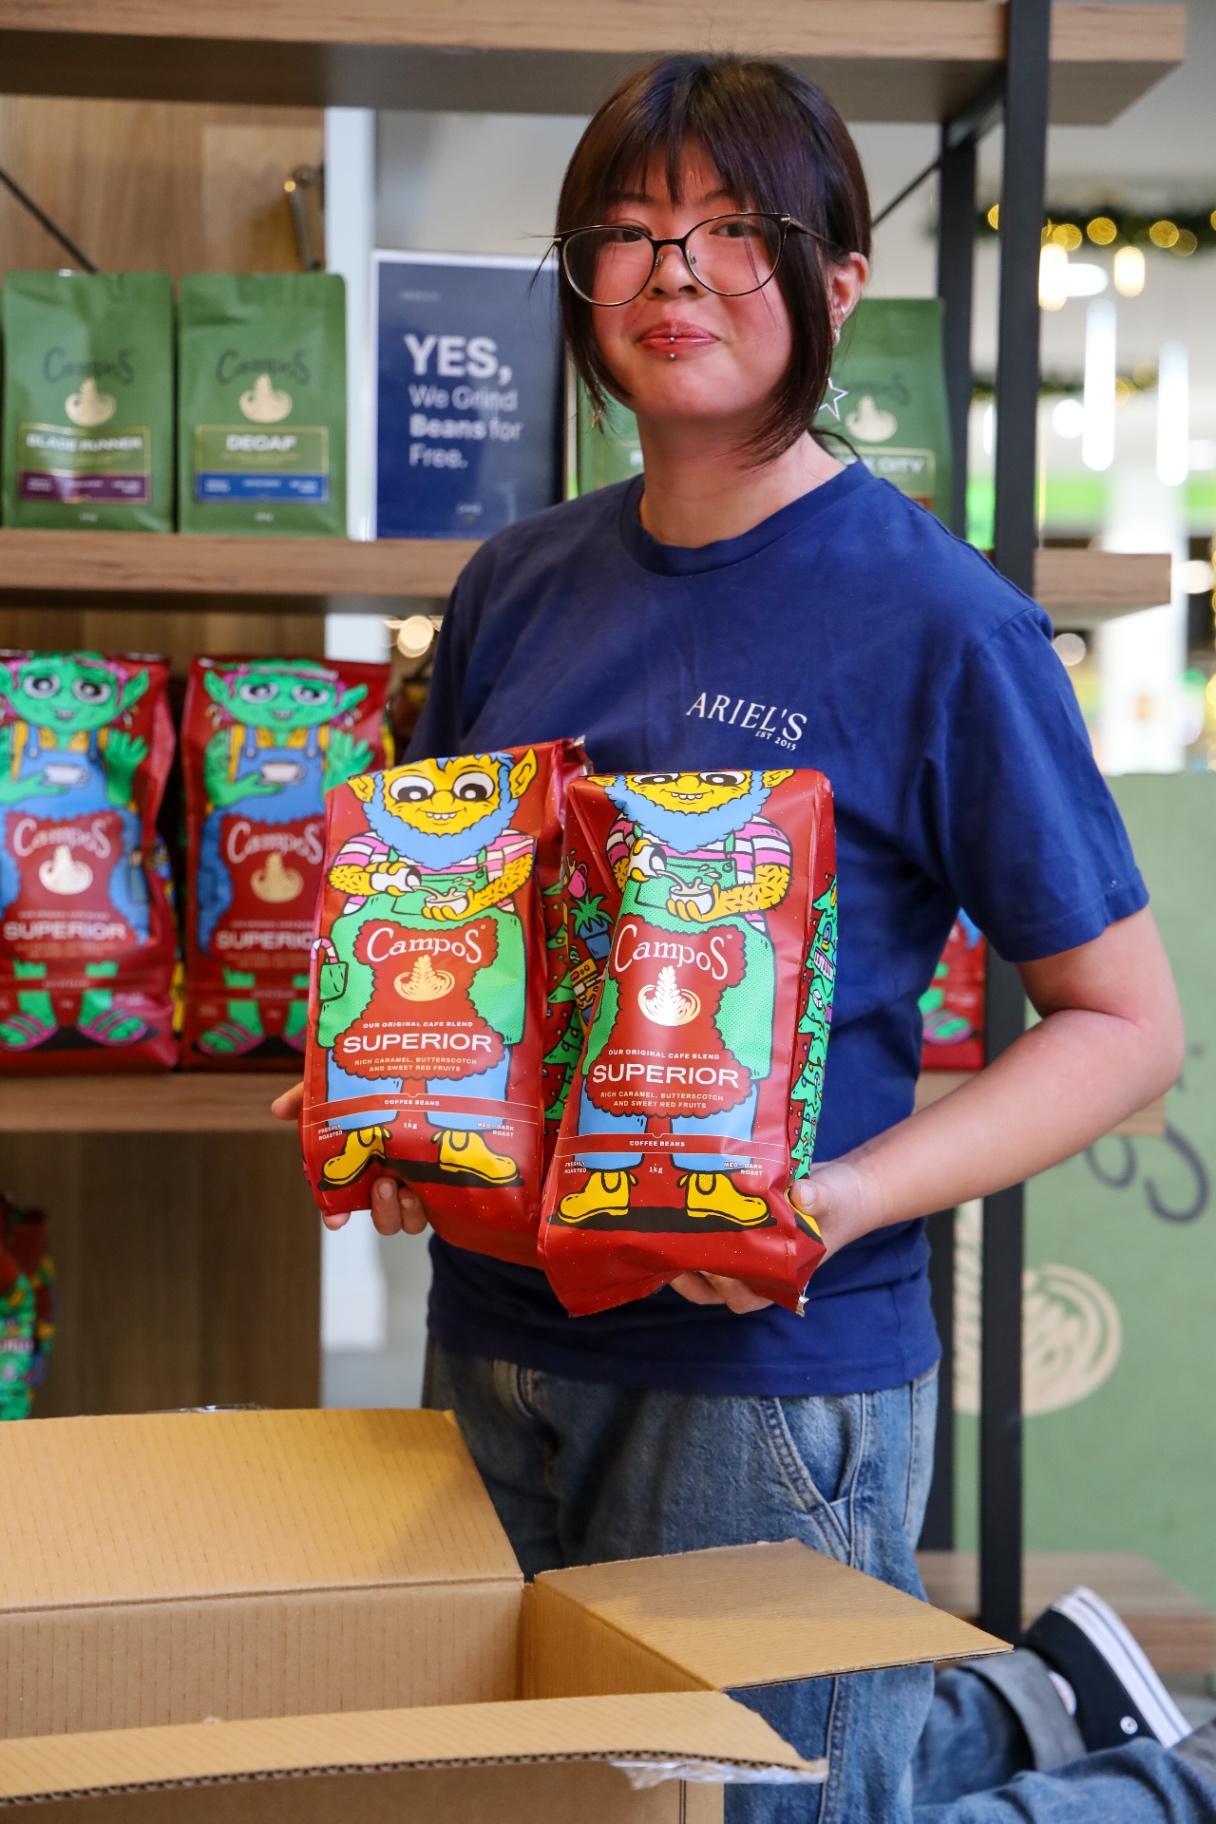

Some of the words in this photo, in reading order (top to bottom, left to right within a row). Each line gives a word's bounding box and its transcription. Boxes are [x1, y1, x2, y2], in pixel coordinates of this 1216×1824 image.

[404, 333, 512, 386] YES,
[408, 384, 450, 409] We
[451, 385, 518, 412] Grind
[409, 413, 487, 440] Beans
[489, 416, 523, 441] for
[226, 434, 297, 452] DECAF
[409, 443, 468, 469] Free.
[877, 456, 925, 475] CITY
[686, 692, 808, 741] ARIEL'S
[755, 731, 773, 740] EST
[774, 737, 797, 751] 2015
[3, 921, 127, 941] SUPERIOR
[215, 930, 313, 950] SUPERIO
[343, 1033, 492, 1053] SUPERIOR
[416, 1057, 477, 1065] BUTTERSCOTCH
[625, 1049, 666, 1058] ORIGINAL
[592, 1063, 739, 1088] SUPERIOR
[619, 1091, 658, 1099] CARAMEL,
[660, 1092, 723, 1101] BUTTERSCOTCH
[318, 1130, 343, 1141] ROASTED
[403, 1122, 417, 1130] 1kg
[649, 1166, 663, 1174] 1kg
